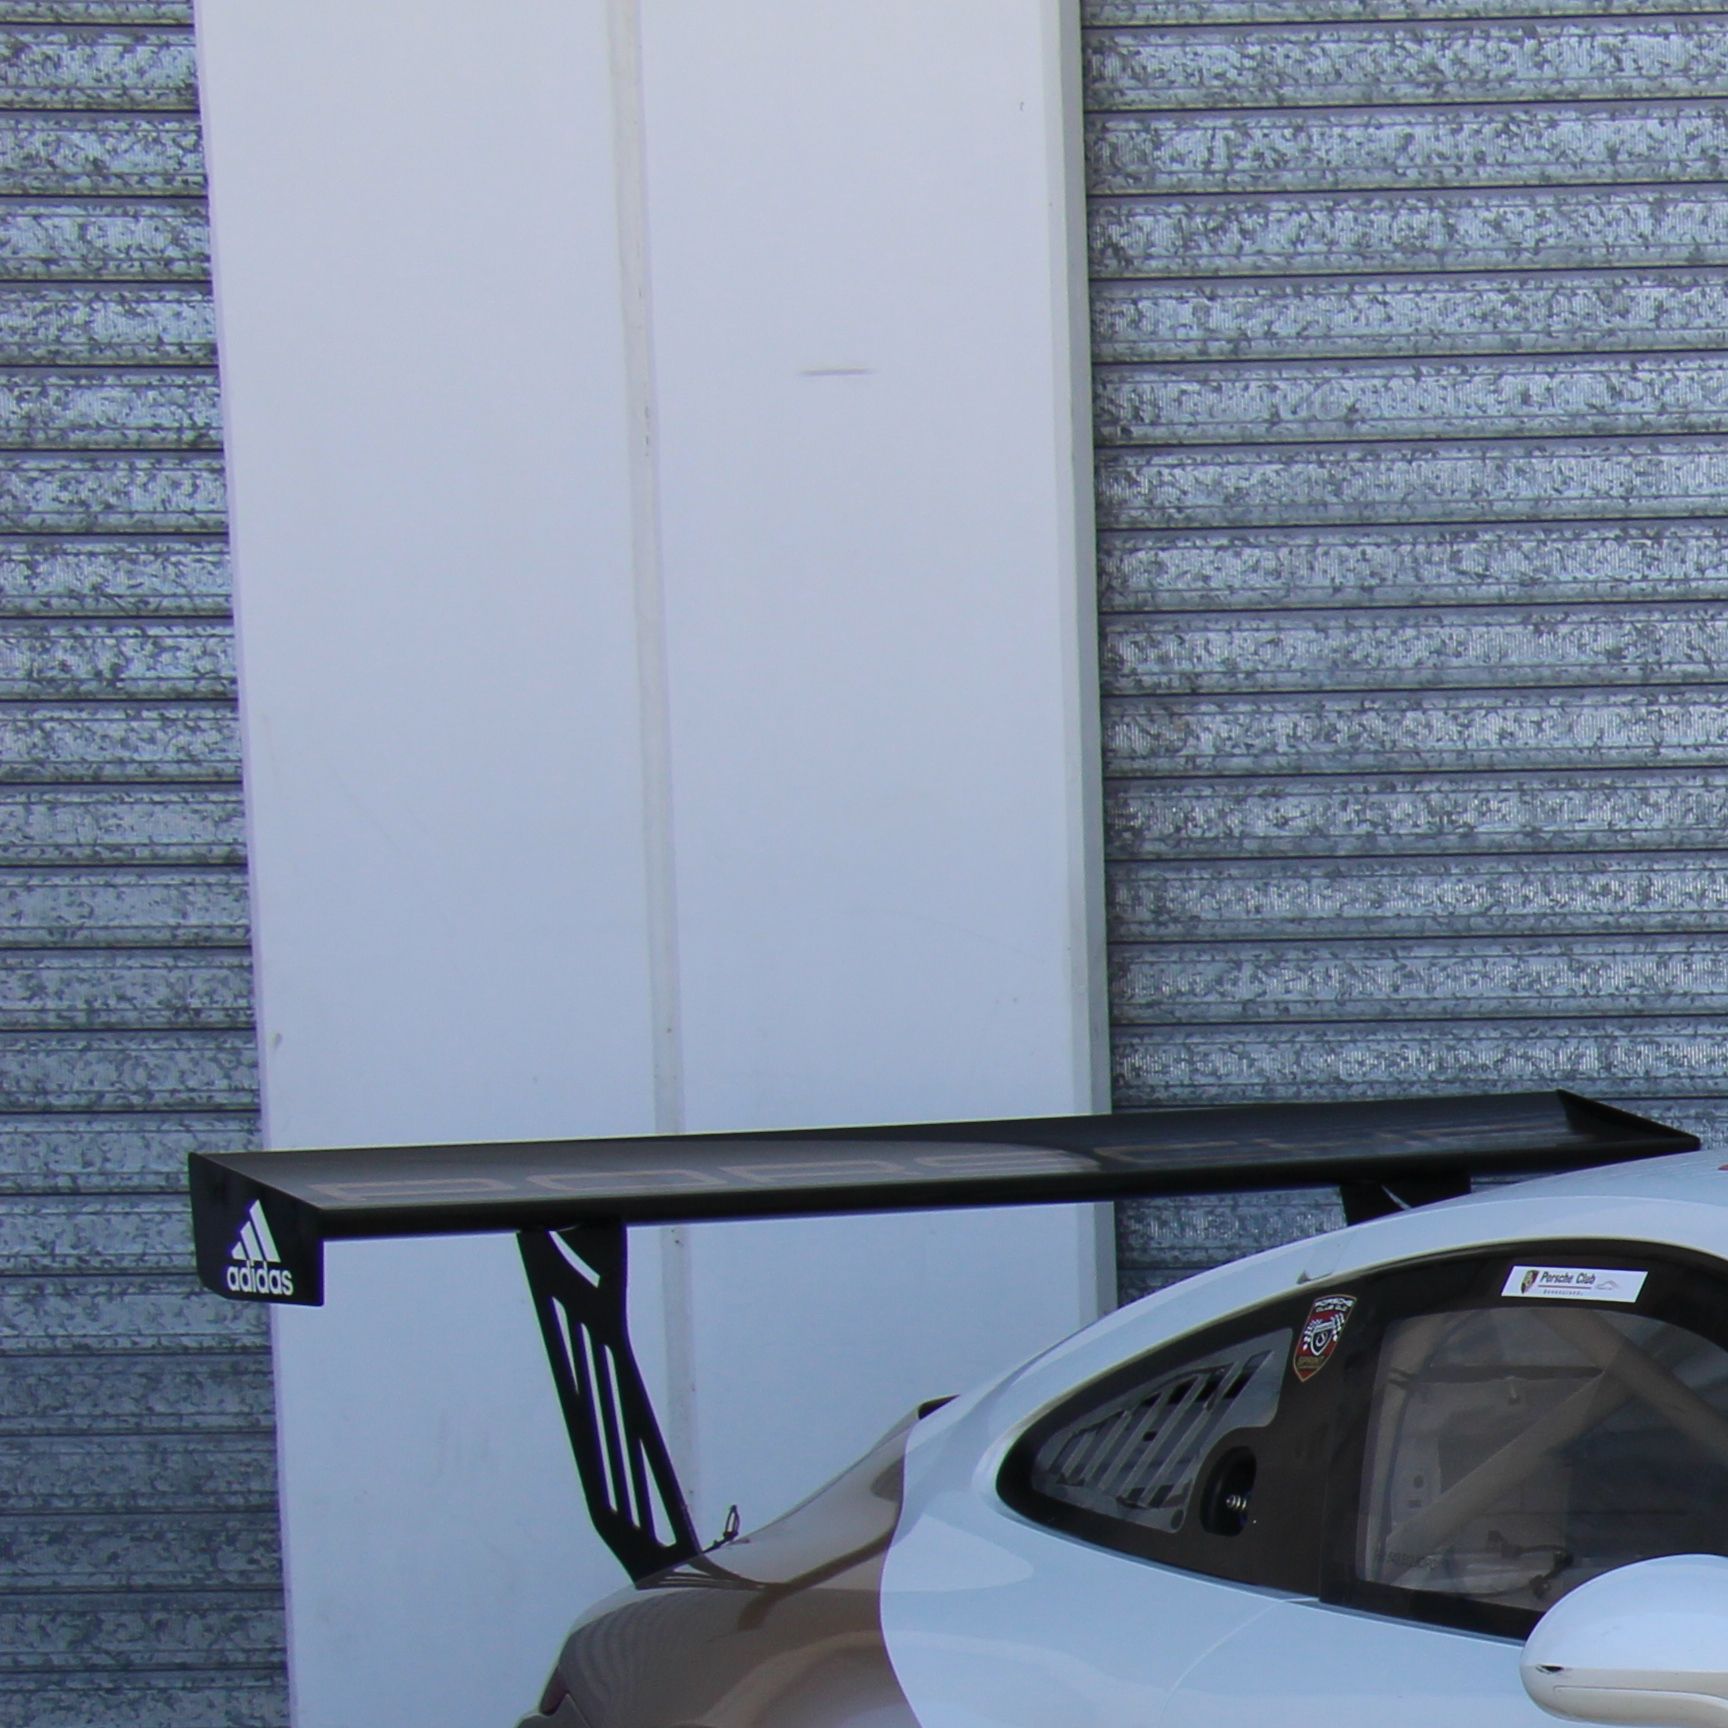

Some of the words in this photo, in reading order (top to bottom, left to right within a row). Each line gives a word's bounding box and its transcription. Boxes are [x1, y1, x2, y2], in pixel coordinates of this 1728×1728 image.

[227, 1259, 294, 1296] adidas
[1540, 1271, 1573, 1284] Porsche
[1576, 1272, 1596, 1285] Club
